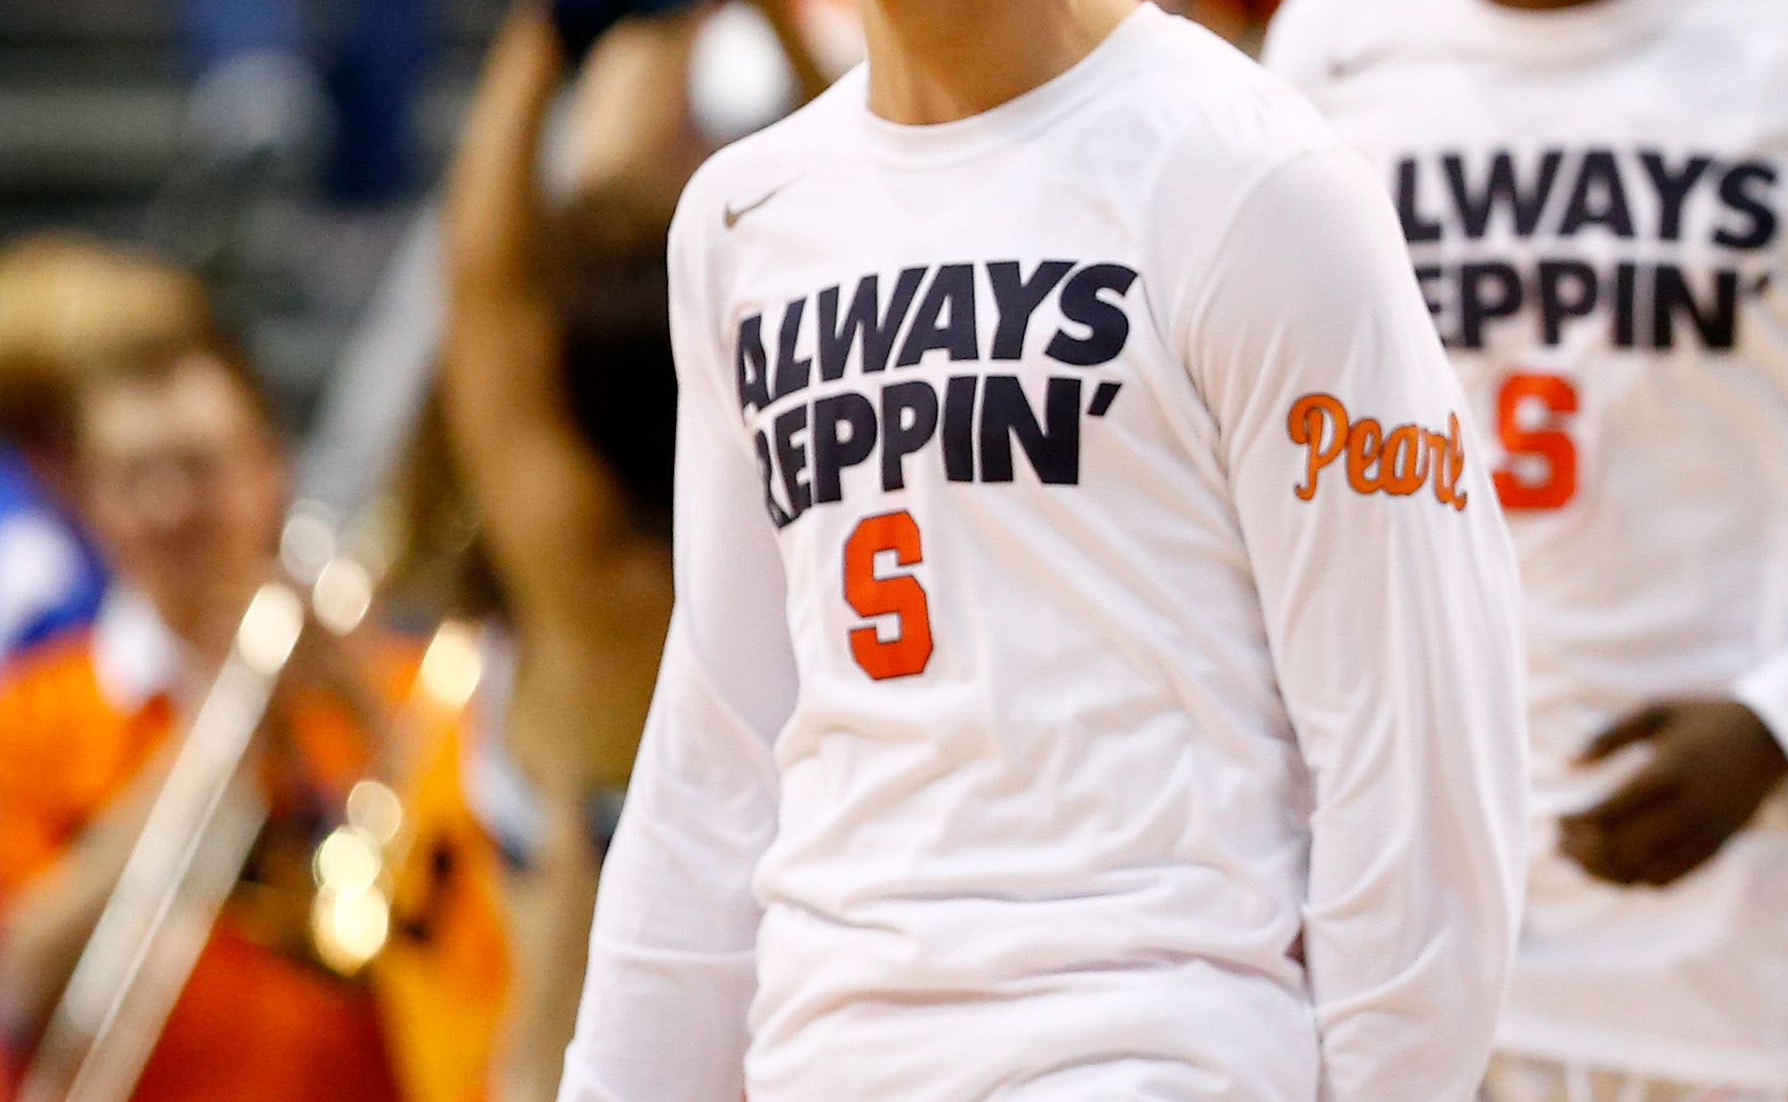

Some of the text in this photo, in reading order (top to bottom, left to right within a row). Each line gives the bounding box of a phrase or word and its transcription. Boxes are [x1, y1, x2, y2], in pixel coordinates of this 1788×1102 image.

[1395, 148, 1779, 250] LWAYS
[738, 259, 1140, 418] ALWAYS
[1413, 260, 1772, 350] EPPIN'
[1287, 393, 1468, 511] Pearl
[1492, 370, 1580, 512] S
[842, 508, 934, 681] S
